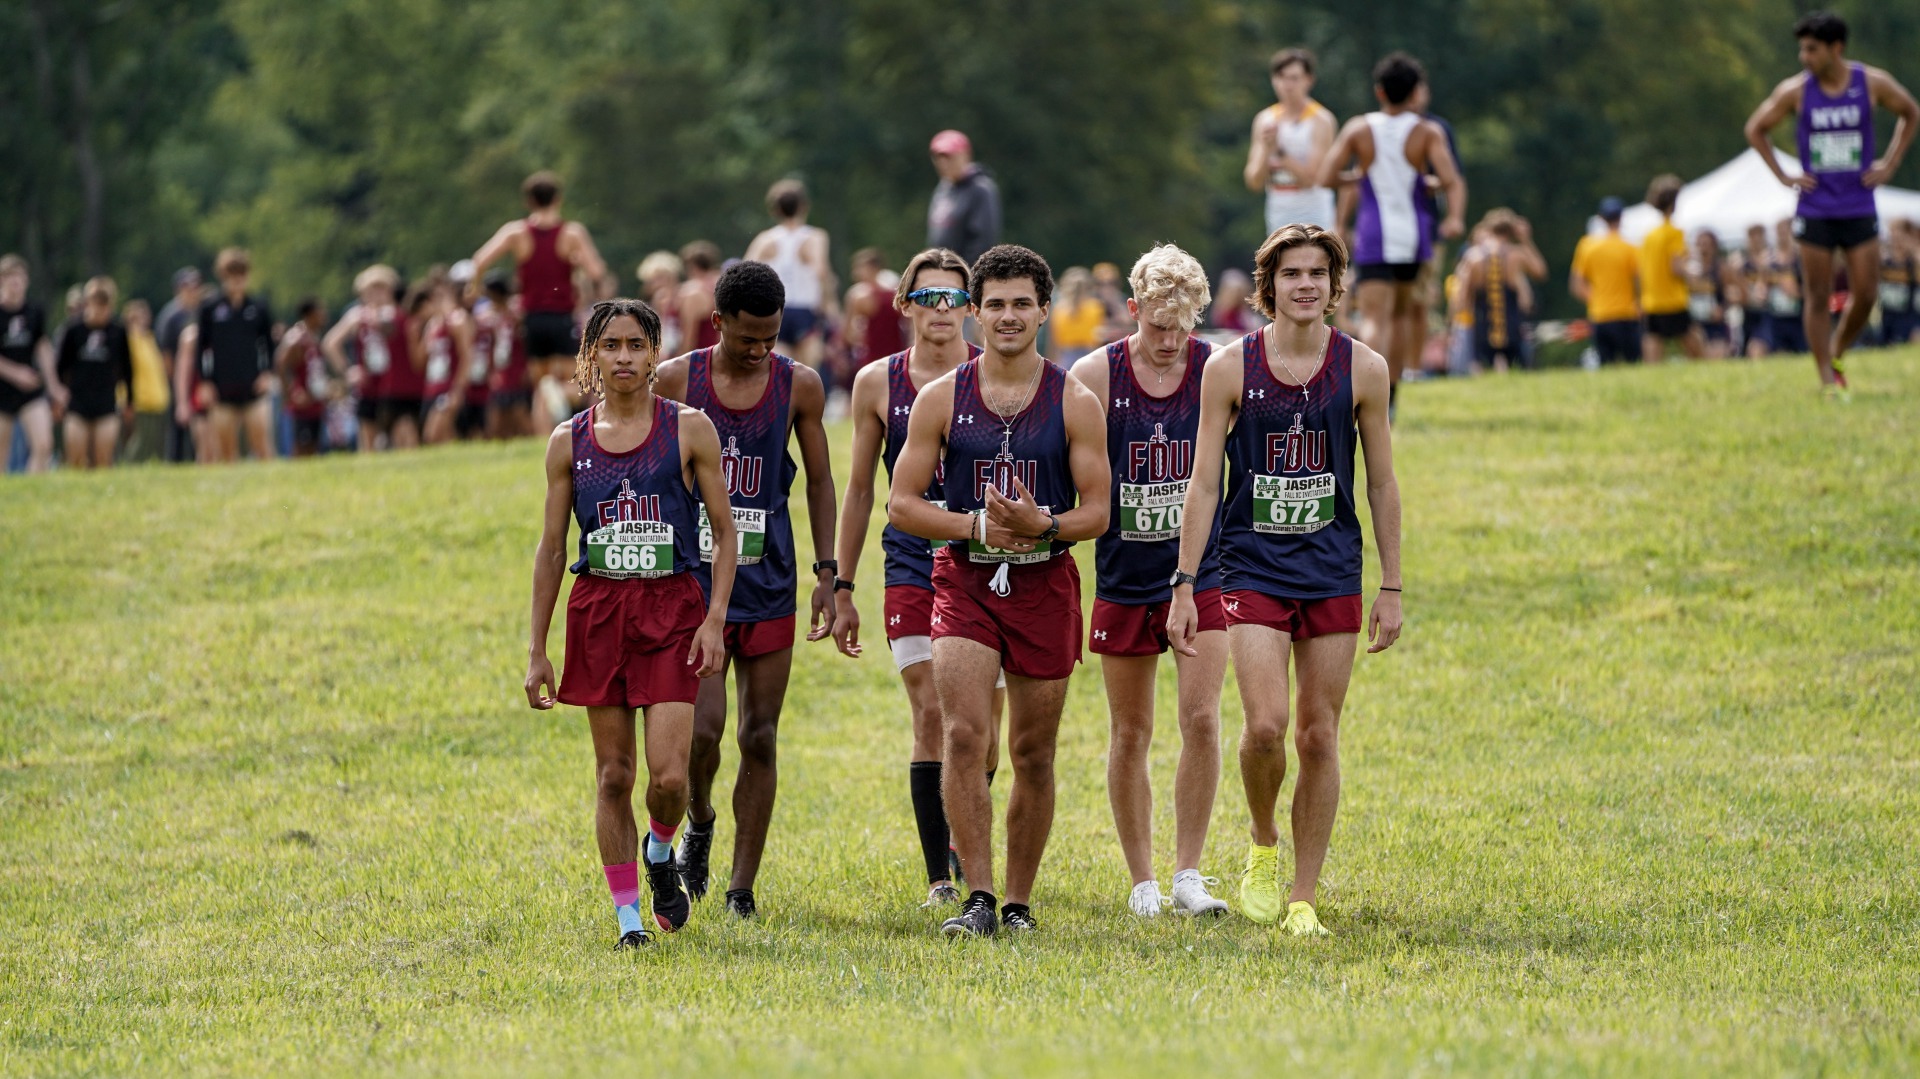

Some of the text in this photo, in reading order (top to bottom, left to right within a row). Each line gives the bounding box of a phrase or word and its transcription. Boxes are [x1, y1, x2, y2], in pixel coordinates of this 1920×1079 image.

[1811, 105, 1861, 130] NYU
[1129, 440, 1190, 482] FDU
[1266, 430, 1326, 474] FDU
[721, 454, 762, 497] DU
[1284, 476, 1331, 491] JASPER
[1302, 488, 1331, 498] INVITATIONAL
[732, 510, 761, 522] SPER
[1136, 505, 1184, 532] 670
[1270, 500, 1320, 524] 672
[619, 522, 668, 534] JASPER
[699, 528, 744, 555] 61
[605, 545, 656, 570] 666
